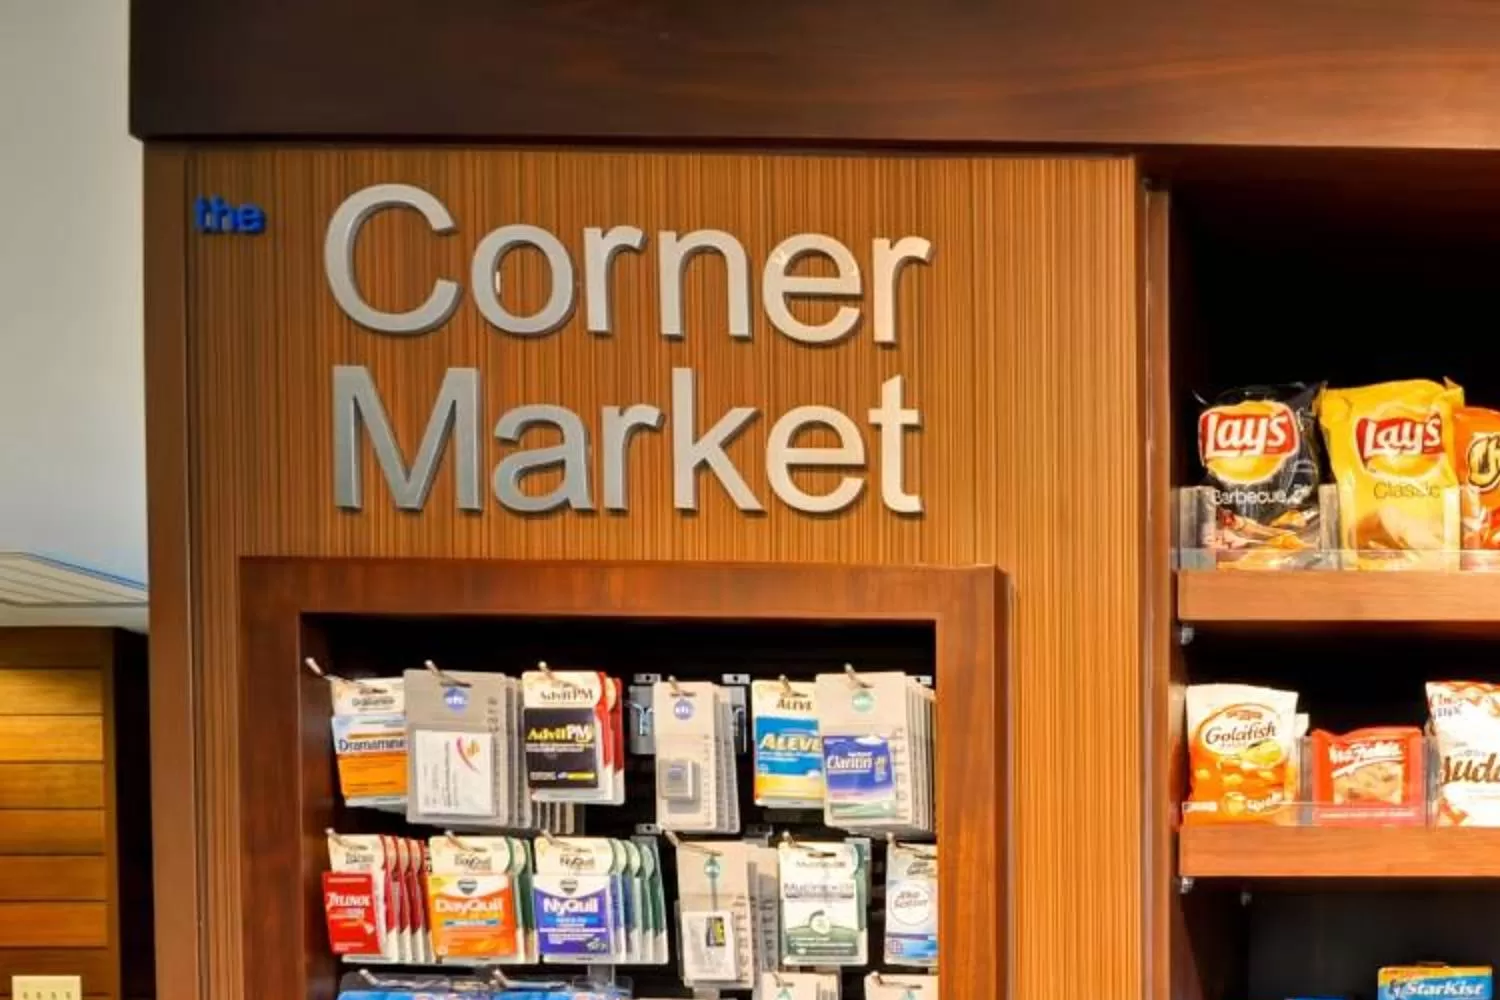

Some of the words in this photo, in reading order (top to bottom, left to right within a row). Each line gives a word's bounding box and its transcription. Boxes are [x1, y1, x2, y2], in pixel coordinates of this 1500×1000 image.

[193, 196, 266, 234] the
[323, 183, 935, 346] Corner
[332, 364, 926, 515] Market
[1374, 481, 1441, 500] Classic
[1205, 720, 1278, 747] Goldfish
[435, 898, 504, 916] DayQuil
[543, 897, 599, 916] NyQuil
[1405, 980, 1485, 996] StarKist
